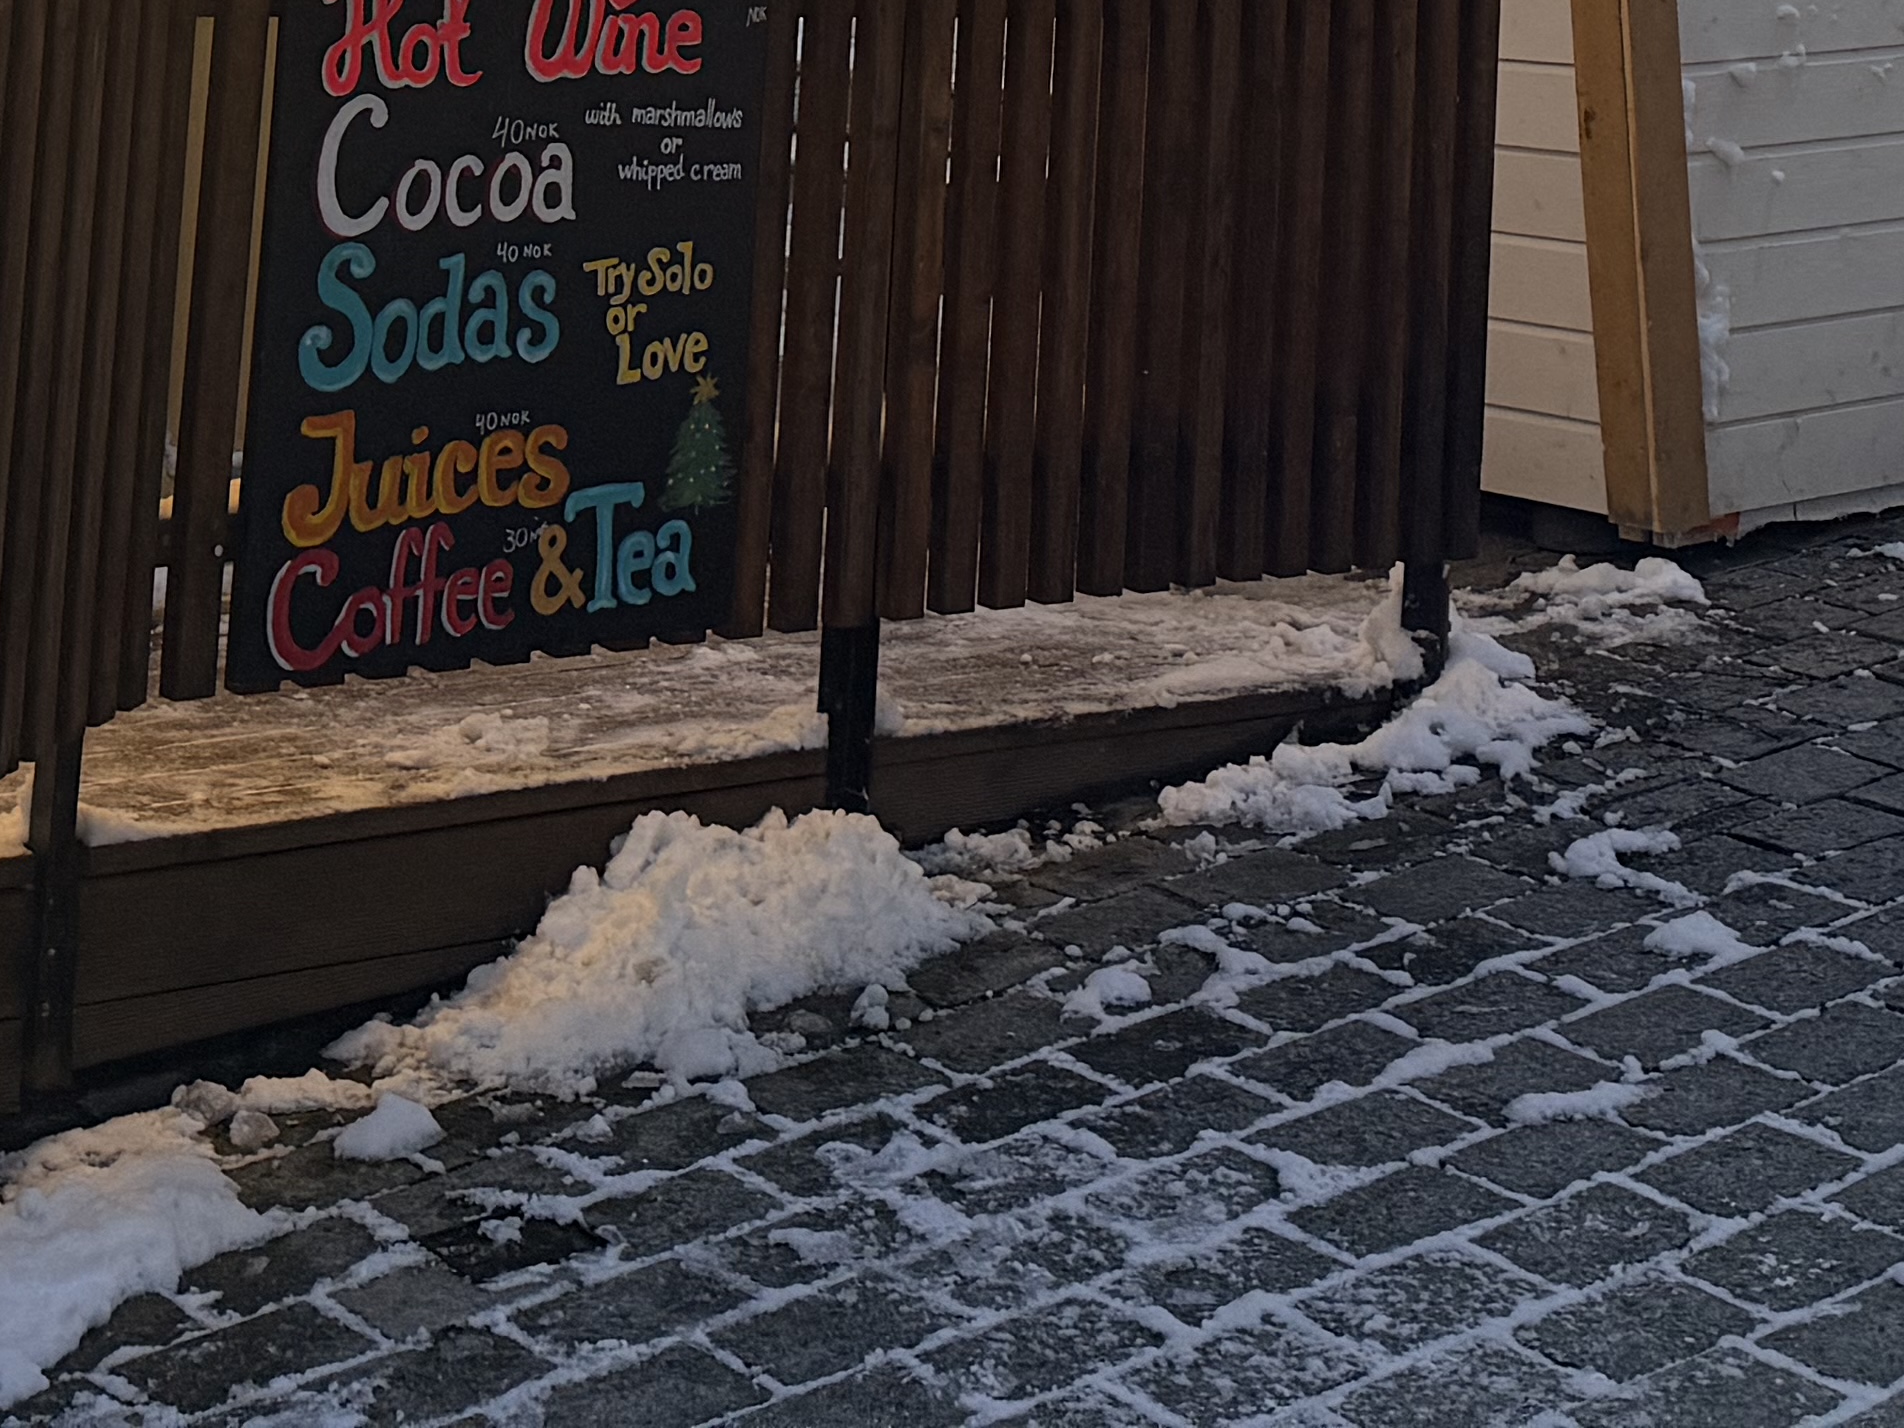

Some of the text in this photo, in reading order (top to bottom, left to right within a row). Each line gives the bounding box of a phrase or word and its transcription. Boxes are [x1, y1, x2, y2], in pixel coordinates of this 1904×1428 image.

[584, 97, 744, 129] with marshmallows
[314, 93, 578, 237] Cocoa
[617, 153, 742, 191] whipped cream
[660, 136, 683, 155] or
[582, 240, 714, 305] Try Solo
[298, 241, 561, 392] Sodas
[606, 302, 648, 336] or
[615, 331, 709, 385] Love
[281, 408, 571, 547] Juices
[266, 481, 698, 671] Coffee & Tea
